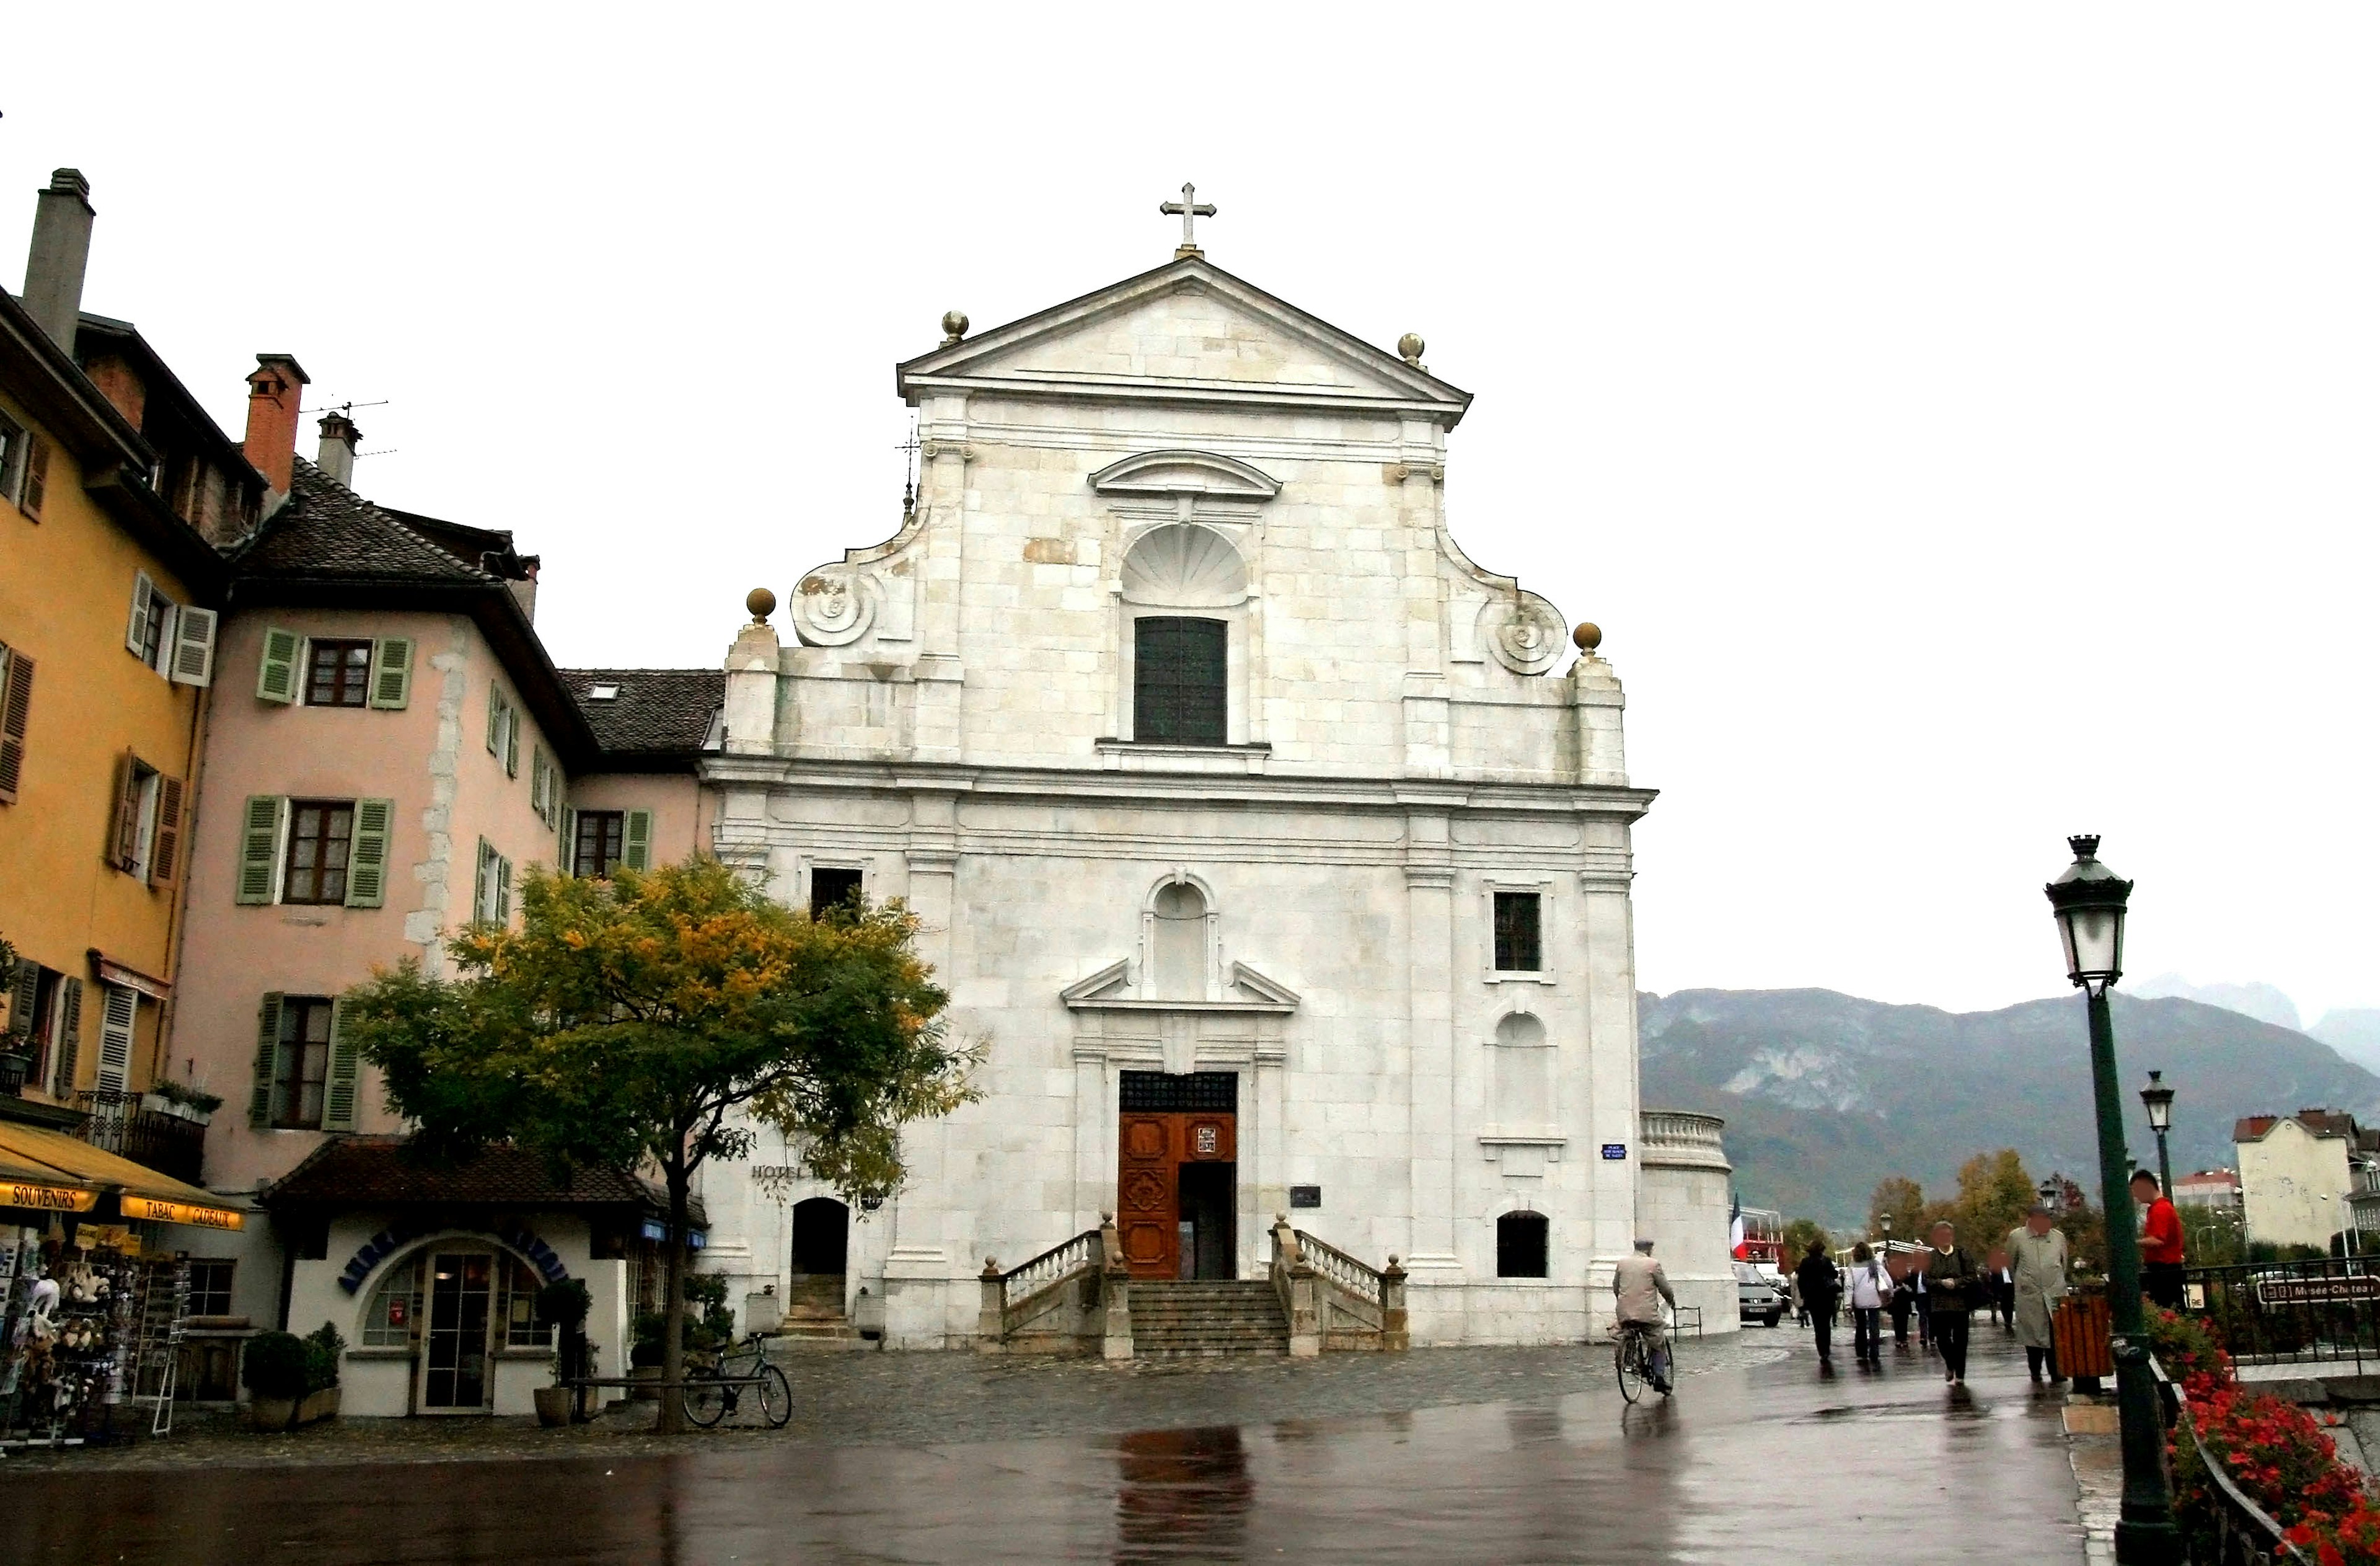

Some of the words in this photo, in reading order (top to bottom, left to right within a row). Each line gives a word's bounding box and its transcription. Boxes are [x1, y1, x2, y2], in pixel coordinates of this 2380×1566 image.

[12, 1185, 76, 1209] SOUVENIRS
[146, 1201, 175, 1221] TABAC
[192, 1208, 230, 1228] CADEAUX
